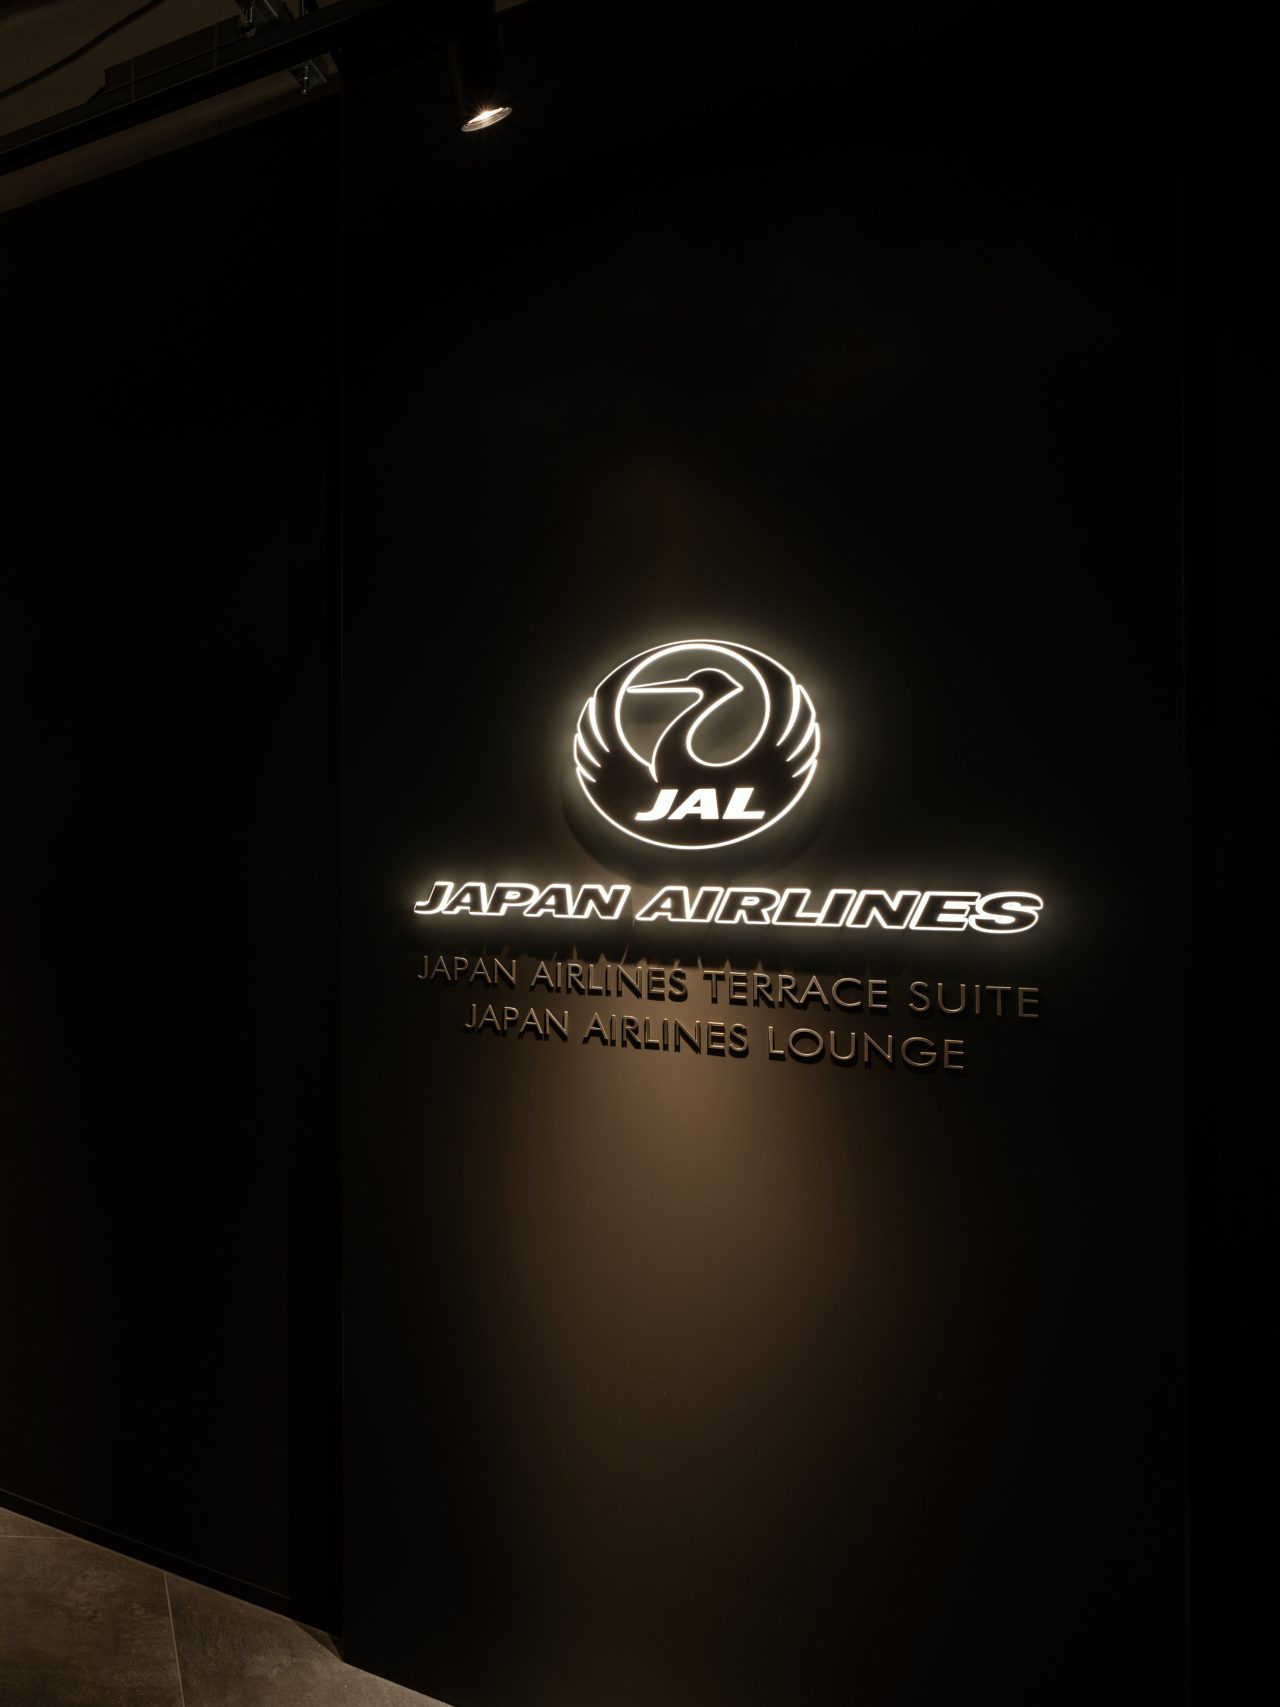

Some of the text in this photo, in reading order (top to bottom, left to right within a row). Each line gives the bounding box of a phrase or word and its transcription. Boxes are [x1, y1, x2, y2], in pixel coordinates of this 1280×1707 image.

[634, 787, 766, 821] JAL
[413, 881, 1044, 934] JAPAN AIRLINES
[417, 955, 1040, 1019] JAPAN AIRLINES TERRACE SUITE
[465, 1003, 965, 1071] JAPAN AIRLINES LOUNGE
